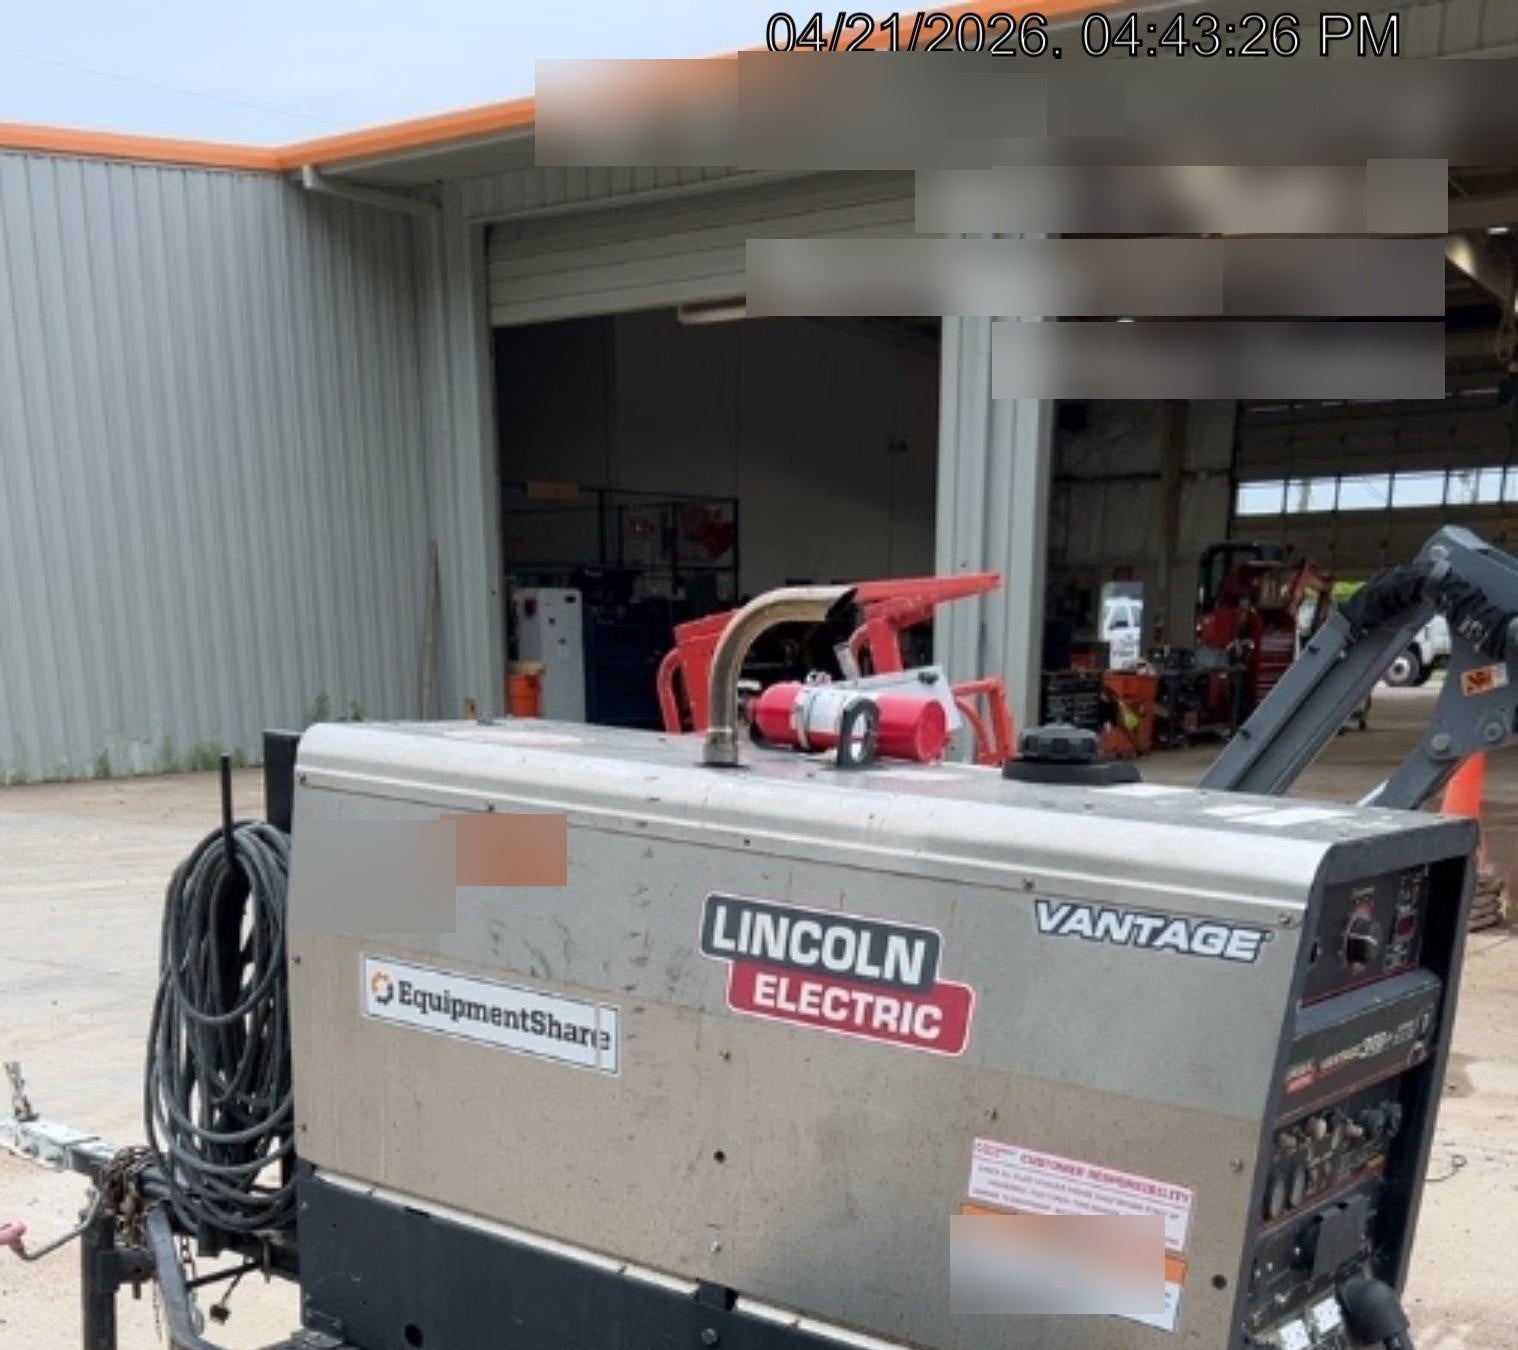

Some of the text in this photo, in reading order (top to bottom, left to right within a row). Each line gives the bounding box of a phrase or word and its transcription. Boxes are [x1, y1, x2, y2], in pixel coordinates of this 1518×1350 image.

[712, 905, 925, 985] LINCOLN
[1036, 900, 1262, 962] VANTAGE
[398, 980, 612, 1050] EquipmentShare
[753, 972, 943, 1040] ELECTRIC
